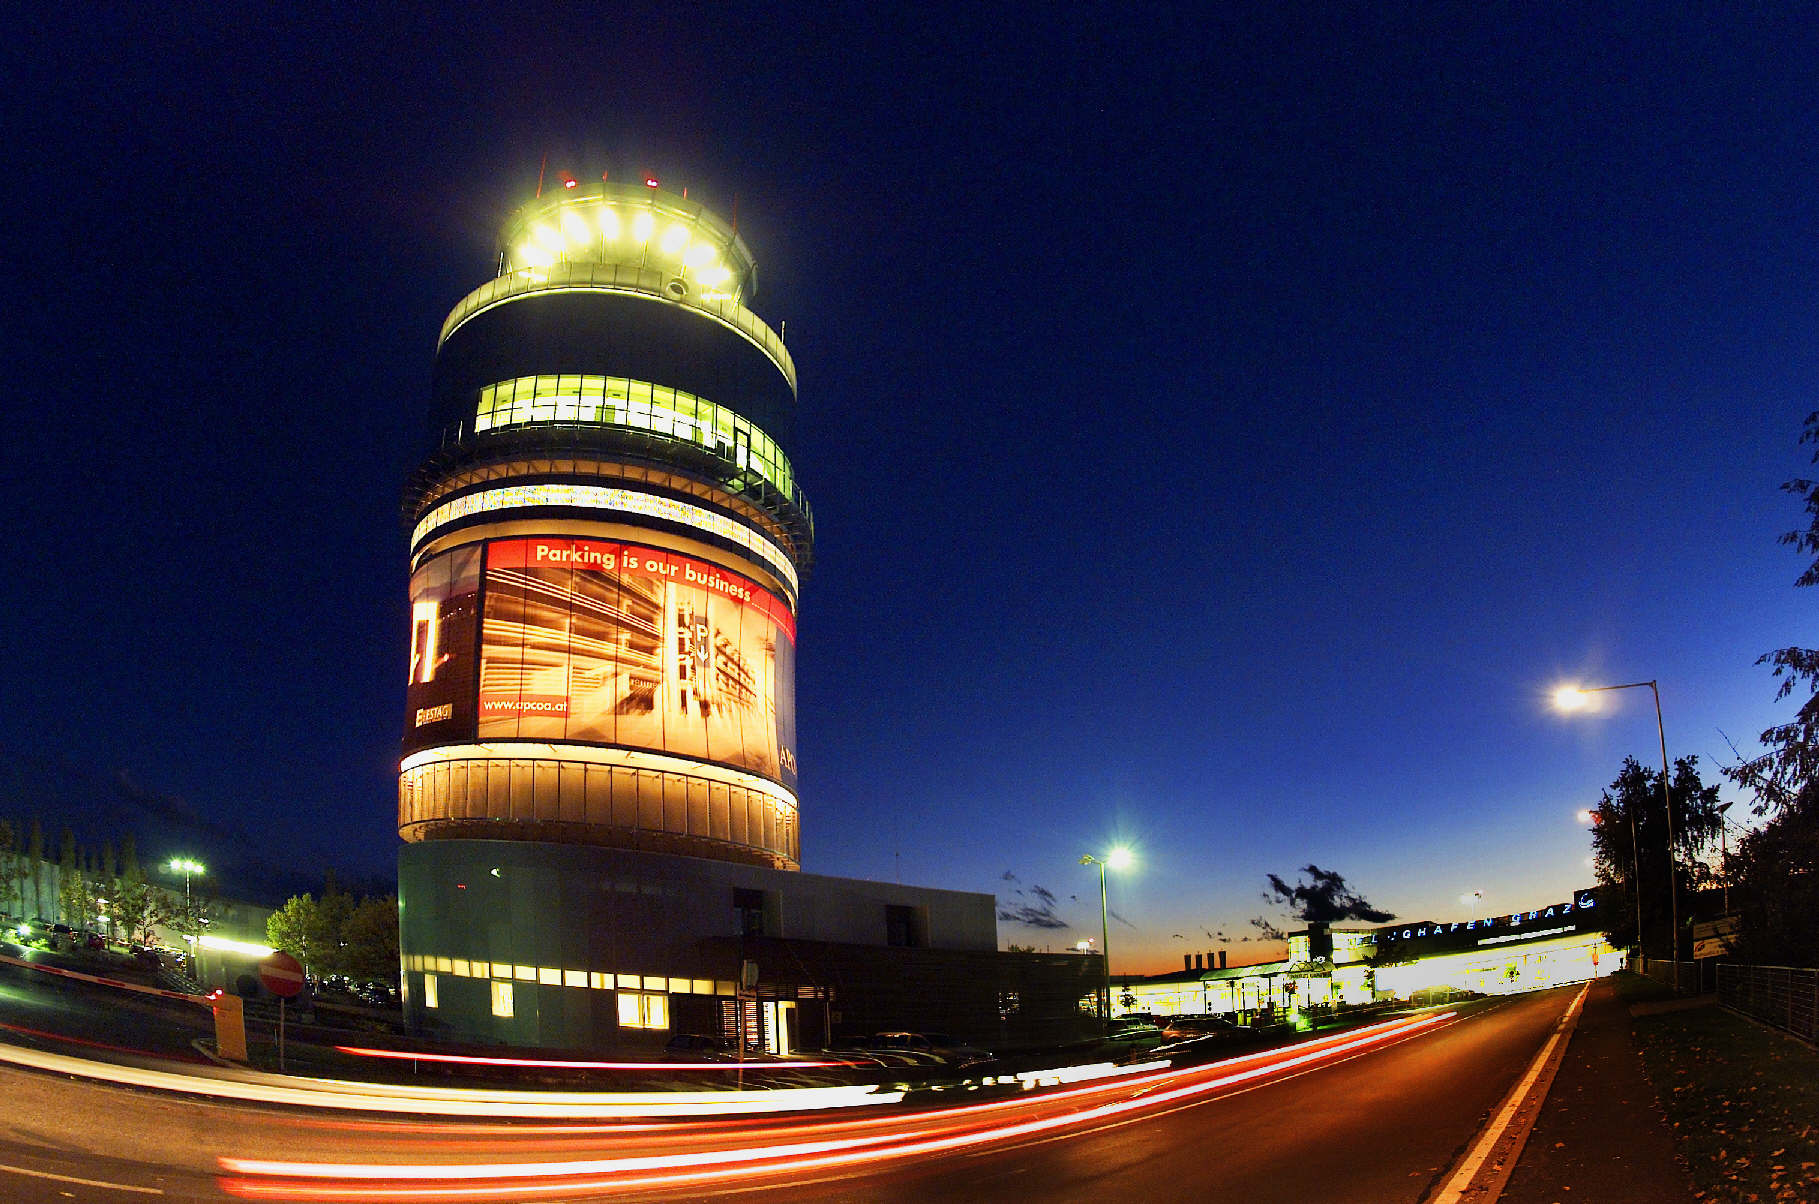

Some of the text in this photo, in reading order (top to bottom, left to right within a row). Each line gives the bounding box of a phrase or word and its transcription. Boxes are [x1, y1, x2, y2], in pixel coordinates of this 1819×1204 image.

[536, 544, 752, 602] Parking is our business
[483, 700, 568, 712] www.apcoa.at
[1511, 903, 1573, 924] GRAZ
